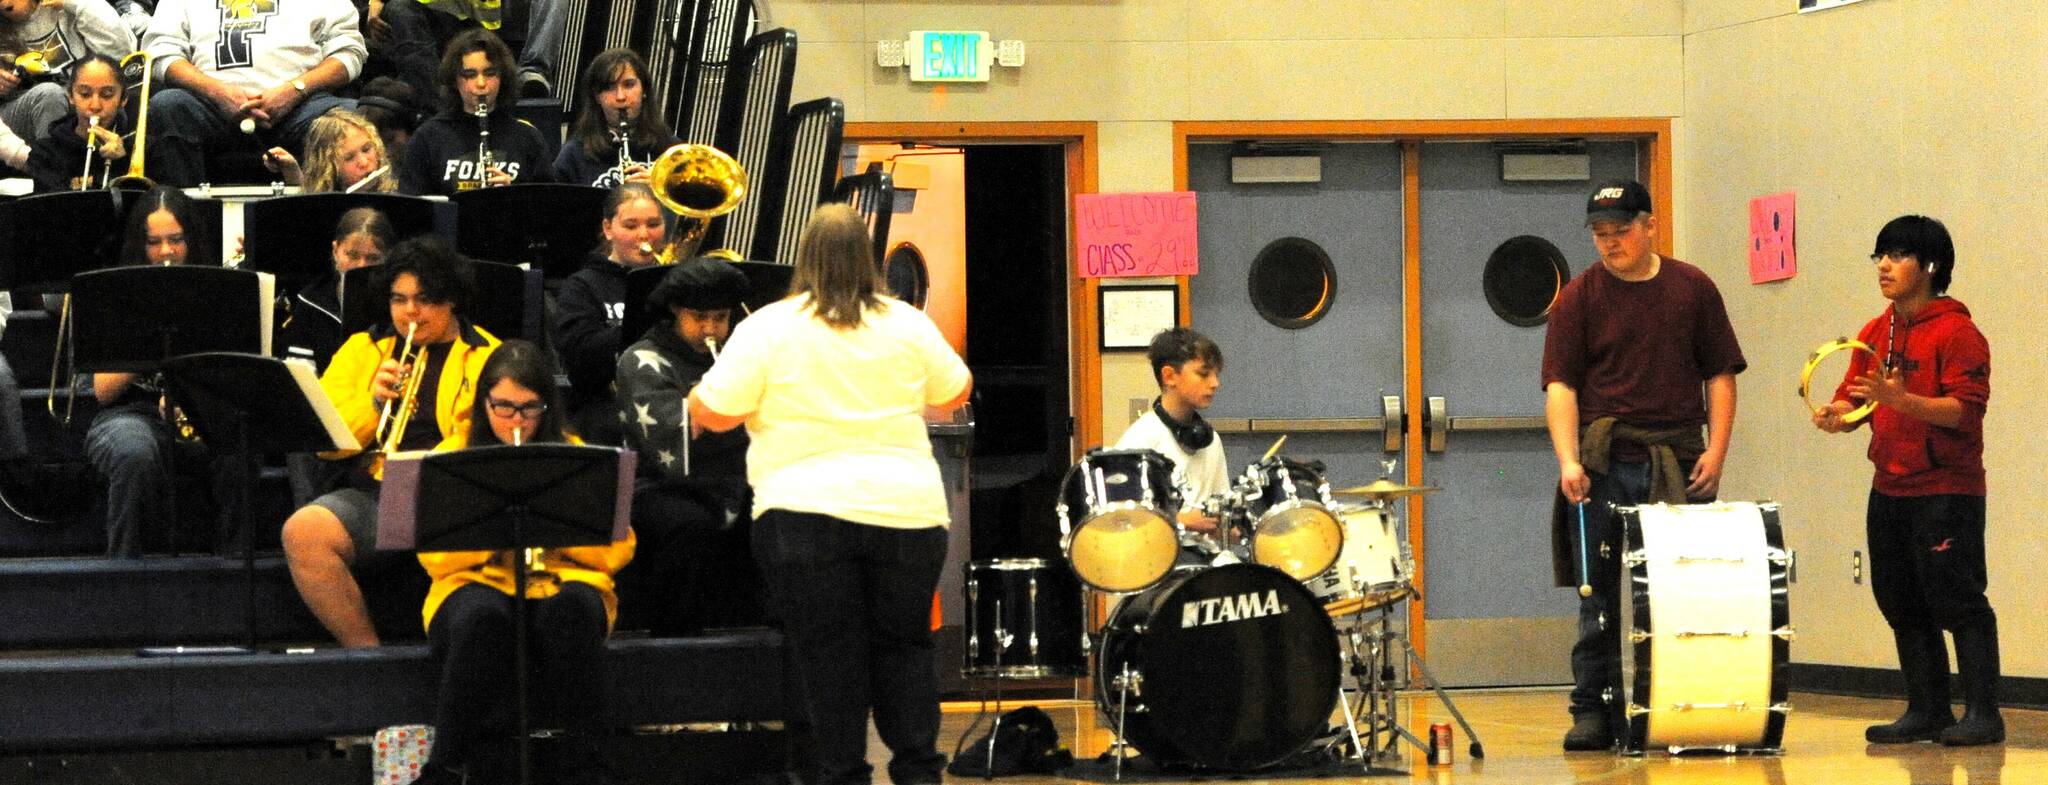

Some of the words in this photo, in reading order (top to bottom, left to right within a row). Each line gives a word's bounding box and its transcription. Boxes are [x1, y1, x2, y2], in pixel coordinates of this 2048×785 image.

[923, 32, 982, 79] EXIT
[1594, 187, 1624, 201] JRG
[1082, 196, 1194, 231] WELCOME
[1200, 589, 1282, 626] TAMA
